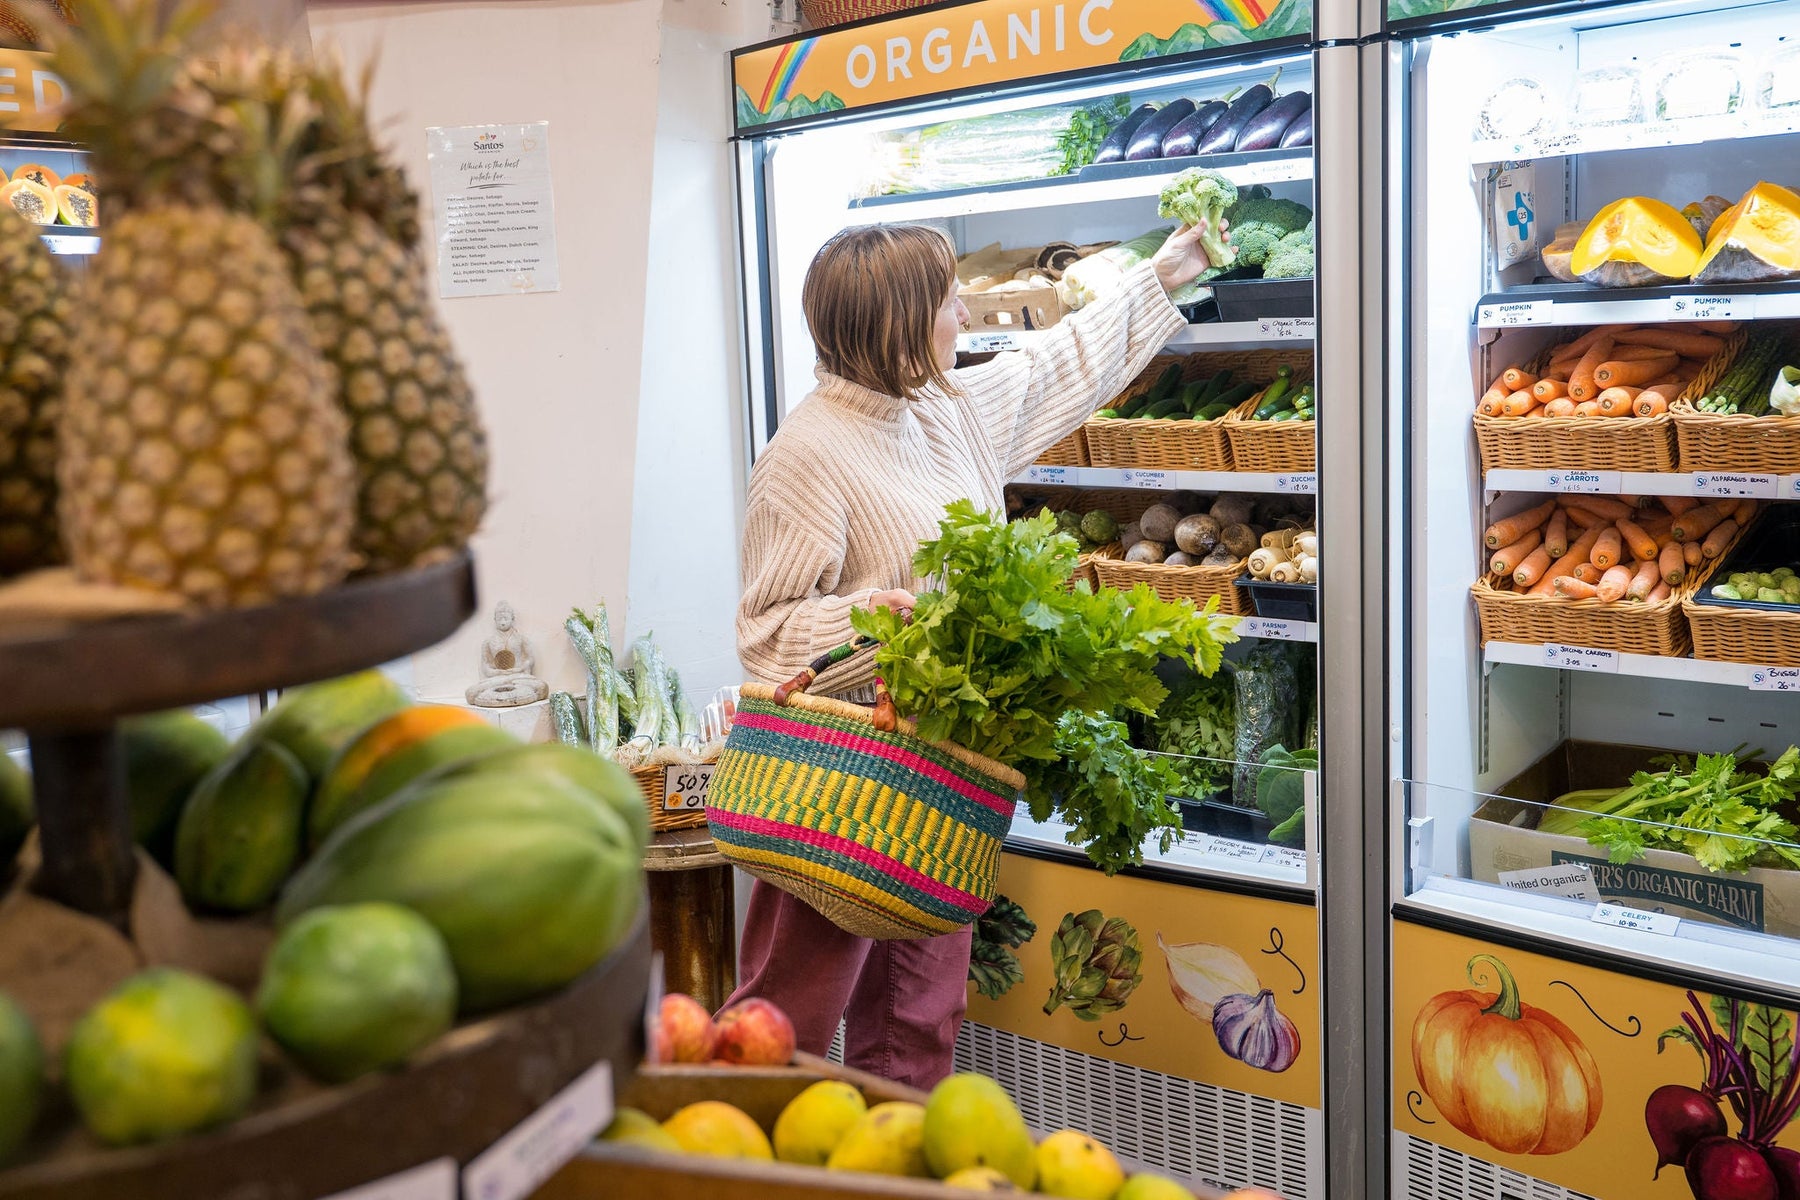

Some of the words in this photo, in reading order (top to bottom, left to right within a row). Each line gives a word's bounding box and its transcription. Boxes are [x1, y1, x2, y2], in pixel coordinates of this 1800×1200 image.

[846, 0, 1114, 89] ORGANIC
[473, 141, 504, 150] Santos
[460, 161, 483, 170] Which
[492, 160, 502, 169] the
[504, 159, 520, 168] best
[470, 172, 491, 185] potato
[1586, 649, 1612, 658] CARROTS
[676, 773, 711, 793] 50%
[1540, 873, 1586, 888] Organics
[1626, 870, 1704, 904] ORGANIC
[1706, 882, 1757, 926] FARM
[1622, 911, 1652, 921] CELERY
